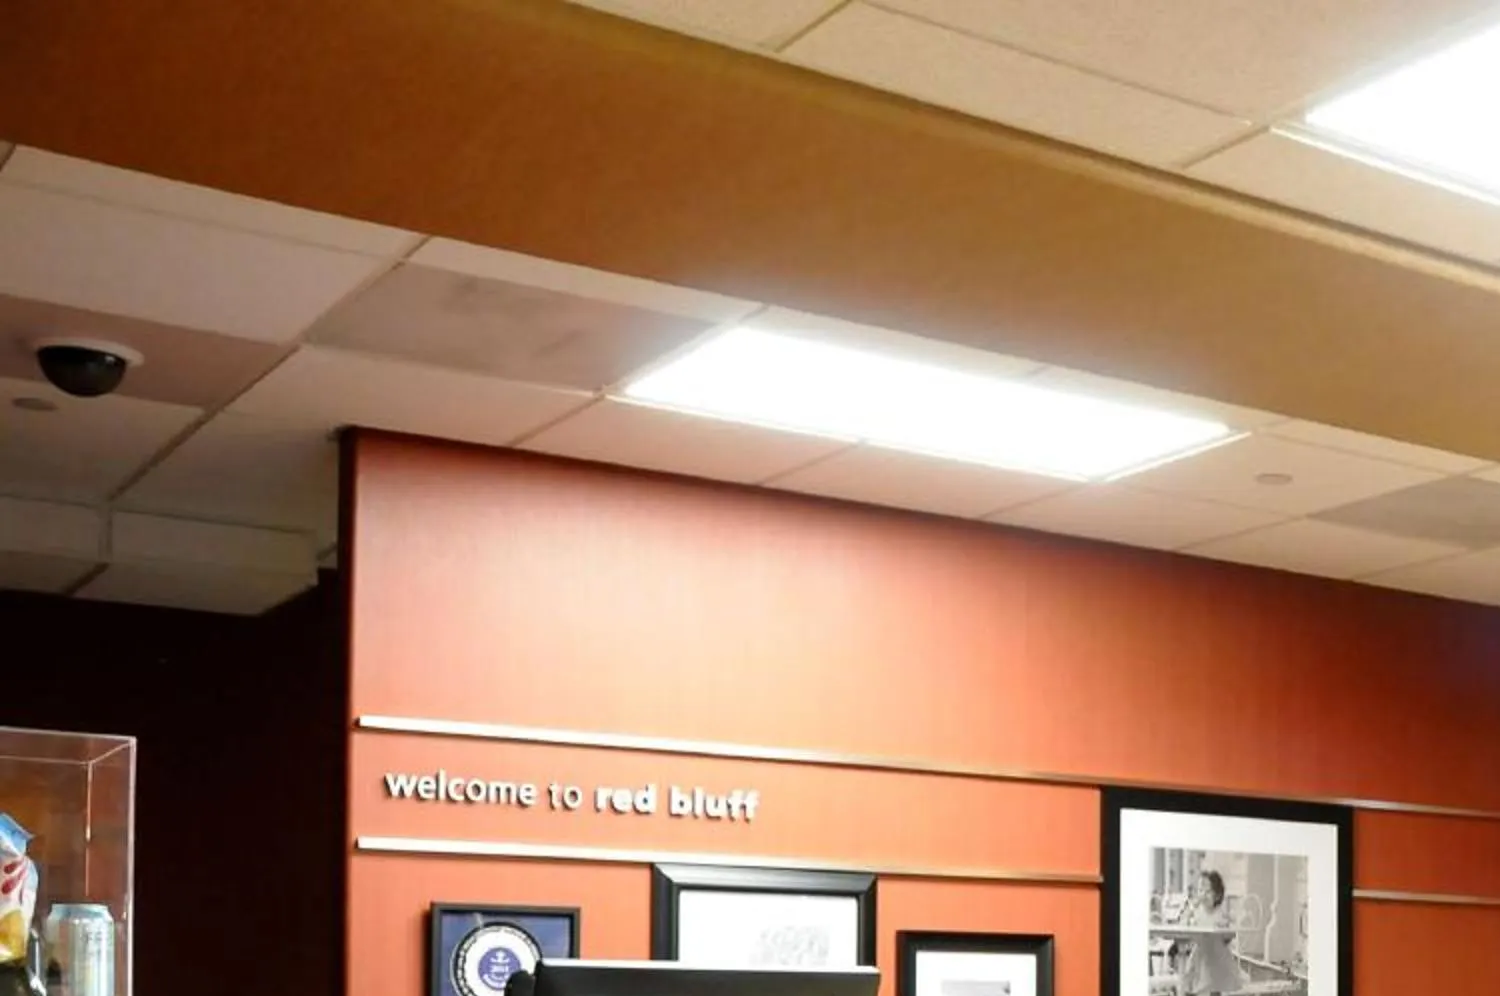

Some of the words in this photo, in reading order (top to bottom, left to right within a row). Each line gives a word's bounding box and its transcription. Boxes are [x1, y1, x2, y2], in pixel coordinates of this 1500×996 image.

[384, 768, 538, 806] welcome
[549, 782, 582, 809] to
[595, 782, 659, 814] red
[669, 784, 761, 821] bluff
